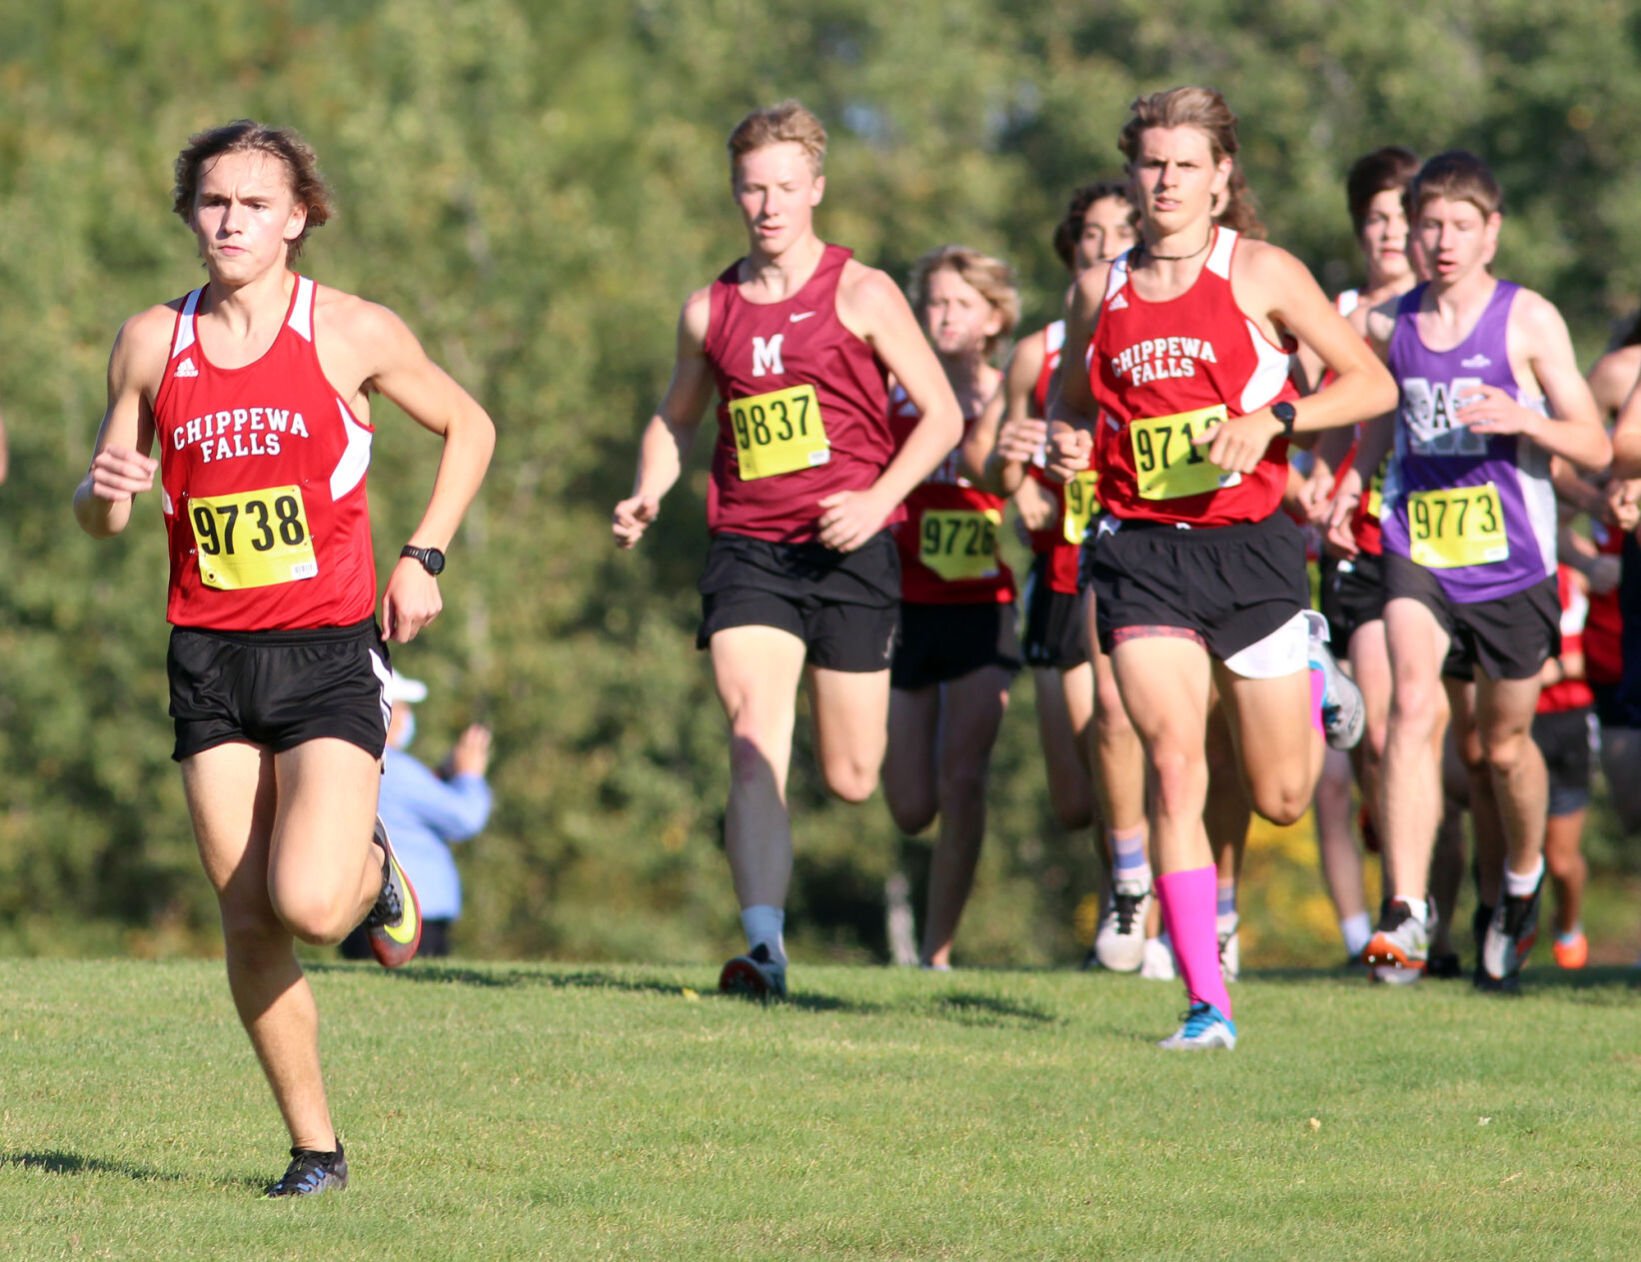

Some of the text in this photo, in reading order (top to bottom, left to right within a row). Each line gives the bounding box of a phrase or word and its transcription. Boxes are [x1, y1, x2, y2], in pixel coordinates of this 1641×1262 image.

[752, 334, 785, 377] M
[1111, 337, 1217, 378] CHIPPEWA
[1132, 358, 1196, 387] FALLS
[173, 407, 309, 451] CHIPPEWA
[734, 395, 811, 450] 9837
[201, 433, 281, 463] FALLS
[193, 495, 305, 556] 9738
[1413, 494, 1499, 540] 9773
